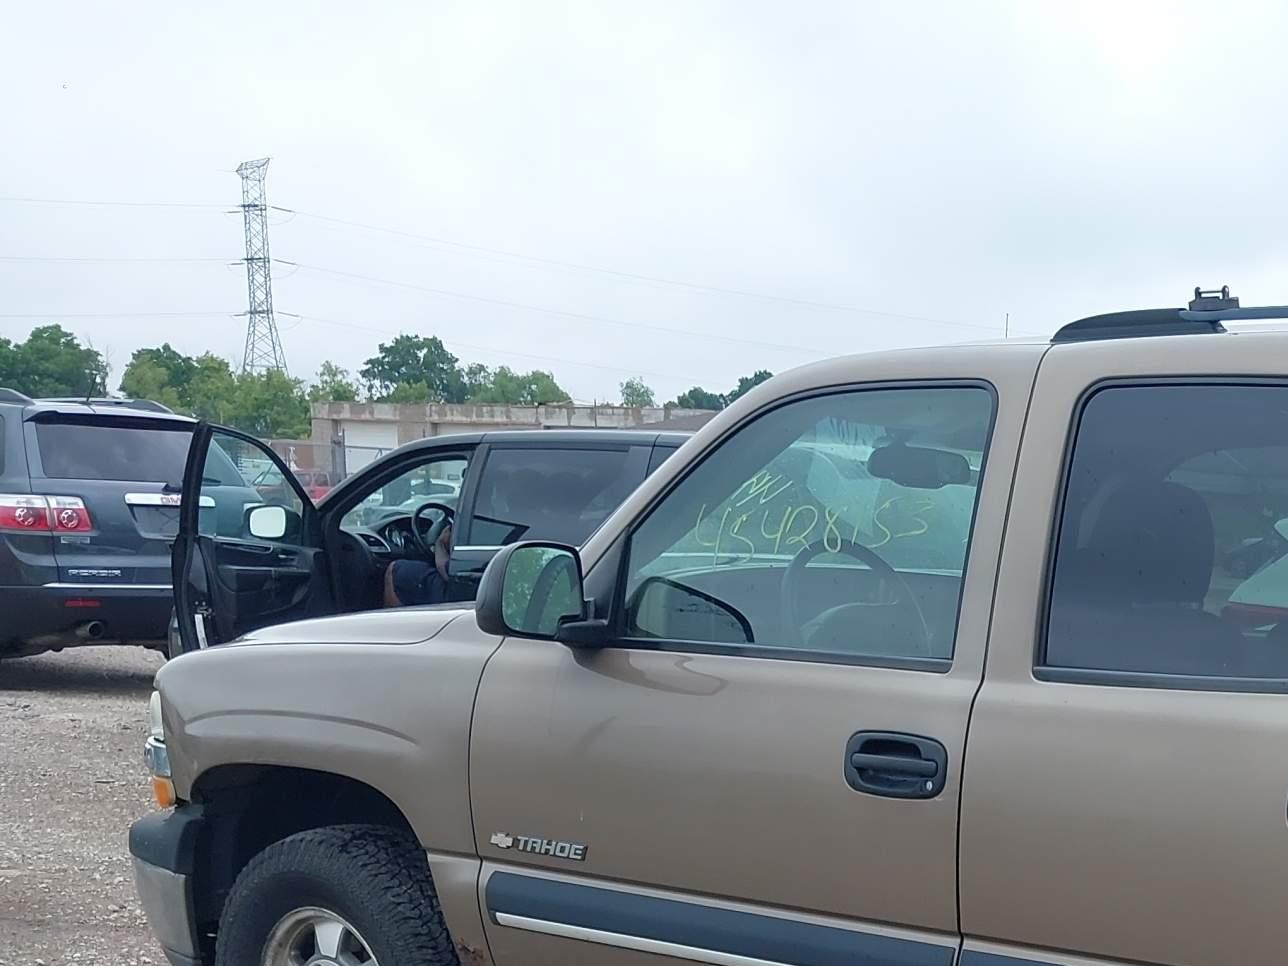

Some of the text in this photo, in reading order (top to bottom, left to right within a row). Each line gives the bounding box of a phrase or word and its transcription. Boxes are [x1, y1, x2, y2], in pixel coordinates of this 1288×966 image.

[160, 496, 181, 505] GM
[695, 496, 935, 569] 45428153
[517, 836, 585, 860] TAHOE
